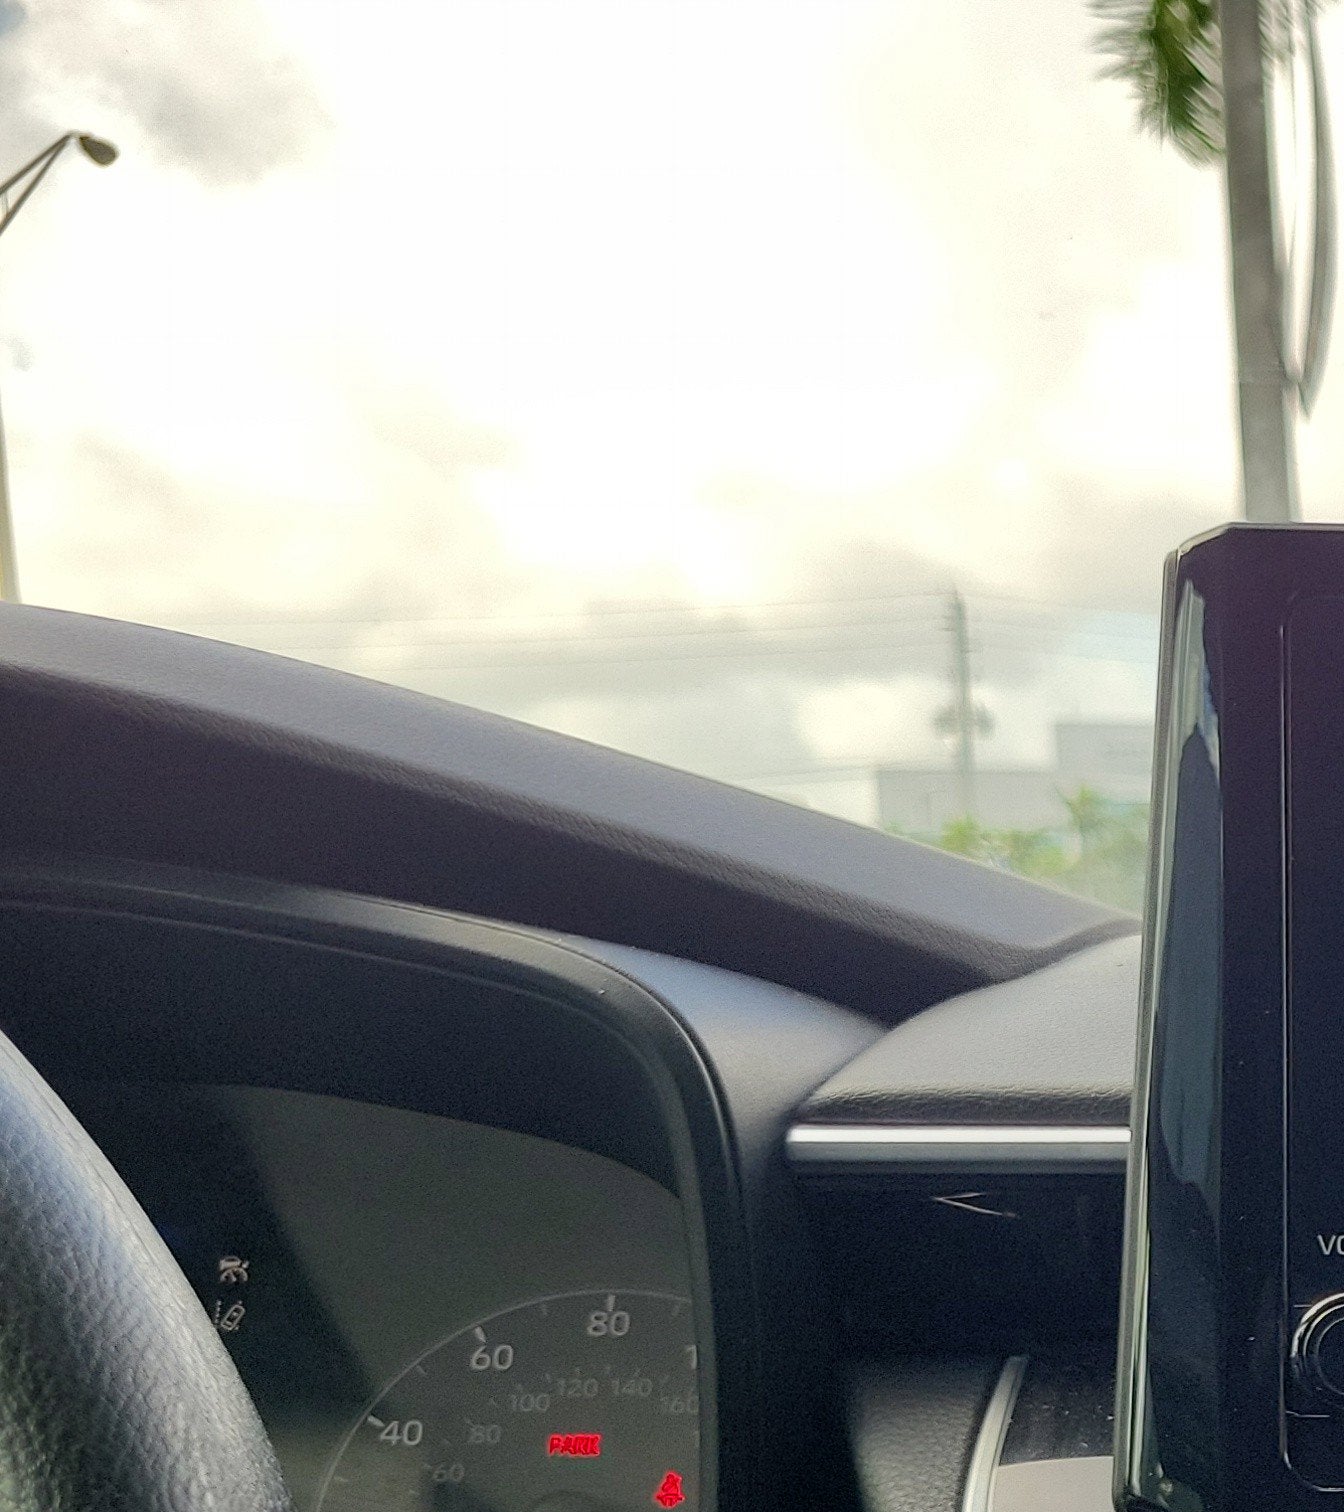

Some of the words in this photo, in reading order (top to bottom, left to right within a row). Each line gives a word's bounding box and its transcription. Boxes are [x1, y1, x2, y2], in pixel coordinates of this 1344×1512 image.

[586, 1310, 631, 1337] 80
[469, 1344, 515, 1371] 60
[556, 1378, 599, 1398] 120
[611, 1378, 653, 1397] 140
[508, 1392, 551, 1414] 100
[380, 1419, 424, 1446] 40
[467, 1424, 500, 1445] 80
[432, 1463, 466, 1483] 60
